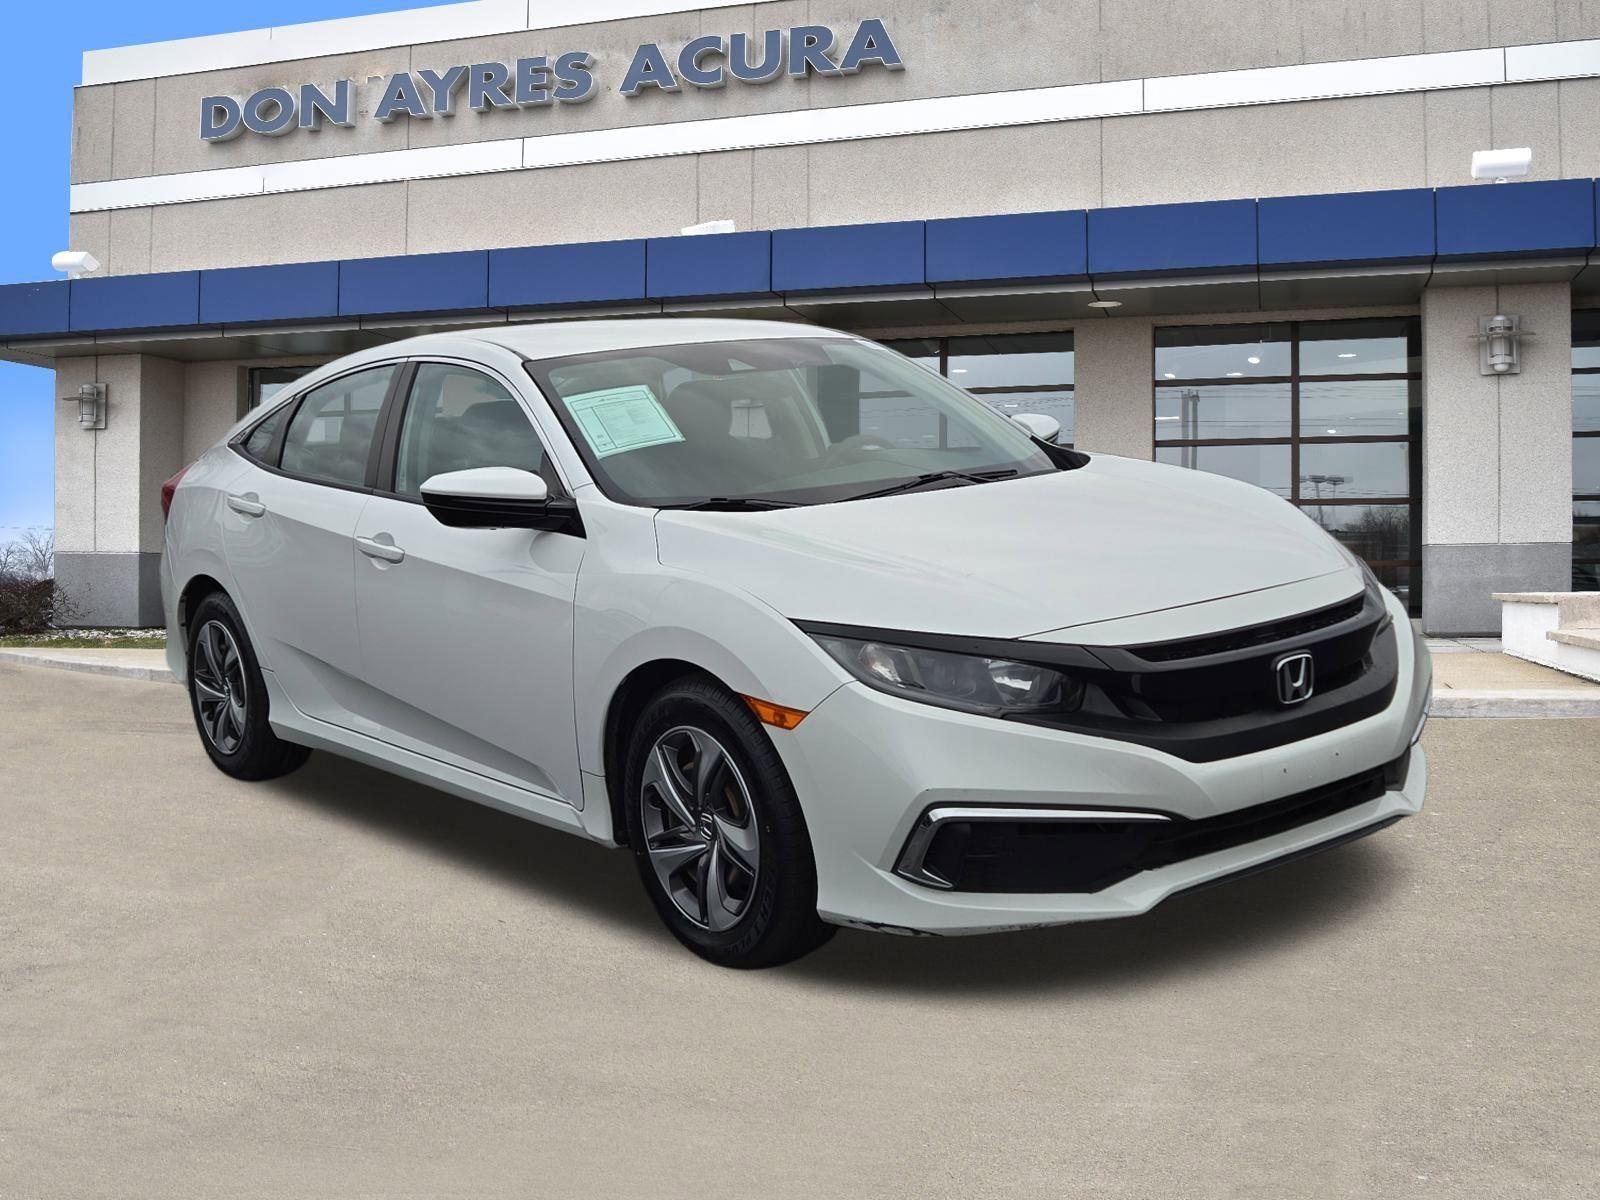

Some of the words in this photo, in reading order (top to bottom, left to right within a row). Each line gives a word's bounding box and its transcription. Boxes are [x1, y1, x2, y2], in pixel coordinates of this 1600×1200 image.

[200, 79, 357, 143] DON
[374, 51, 597, 123] AYRES
[619, 17, 905, 97] ACURA
